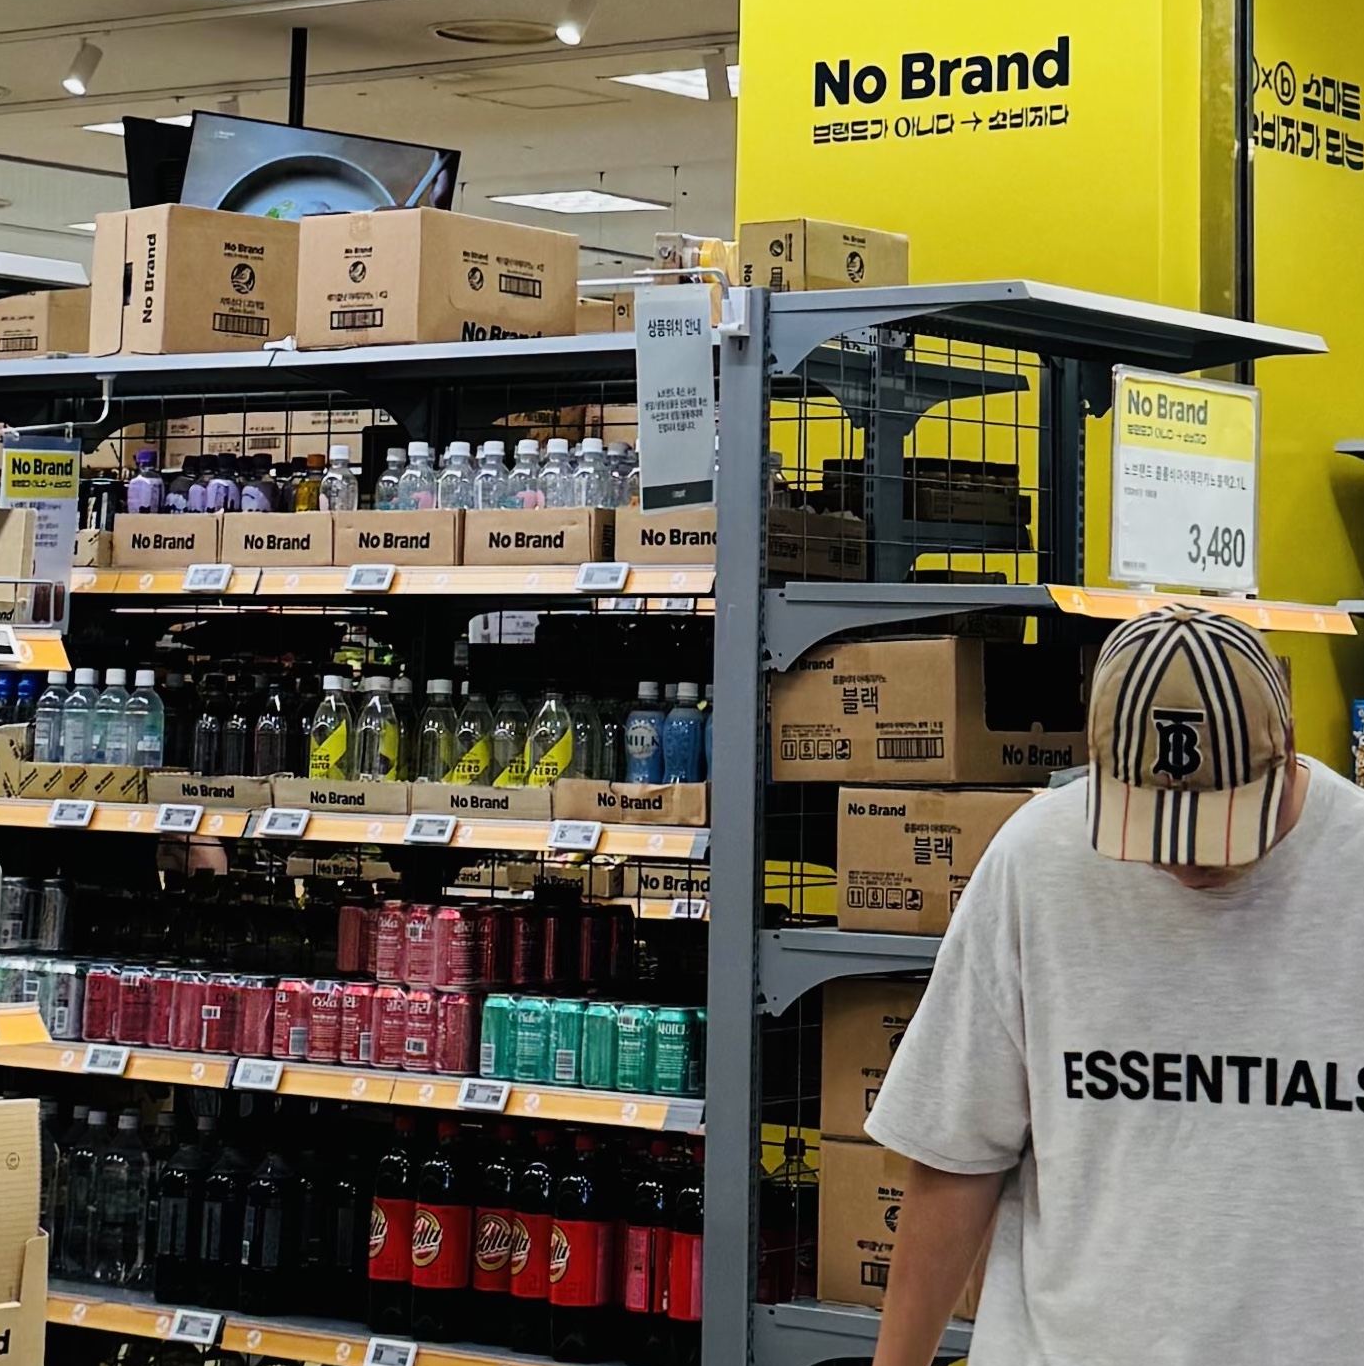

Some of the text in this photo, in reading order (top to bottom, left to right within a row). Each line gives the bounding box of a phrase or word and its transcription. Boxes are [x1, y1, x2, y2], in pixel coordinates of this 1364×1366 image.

[814, 36, 1070, 107] No Brand
[1303, 74, 1360, 121] 스마트
[814, 105, 1069, 144] 브랜드가 아니다 소비자다
[1326, 127, 1364, 170] 되는
[142, 233, 156, 323] No Brand
[647, 318, 701, 338] 상품위치 안내
[1127, 389, 1208, 425] No Brand
[12, 457, 73, 476] No Brand
[131, 533, 195, 549] No Brand
[244, 534, 310, 550] No Brand
[358, 532, 430, 549] No Brand
[488, 531, 564, 548] No Brand
[640, 529, 665, 546] No
[1188, 523, 1246, 571] 3,480
[842, 686, 878, 715] 블랙
[1002, 745, 1022, 765] No
[182, 784, 234, 798] No Brand
[311, 792, 365, 806] No Brand
[450, 795, 508, 810] No Brand
[597, 793, 662, 810] No Brand
[848, 804, 906, 817] No Brand
[914, 836, 953, 866] 블랙
